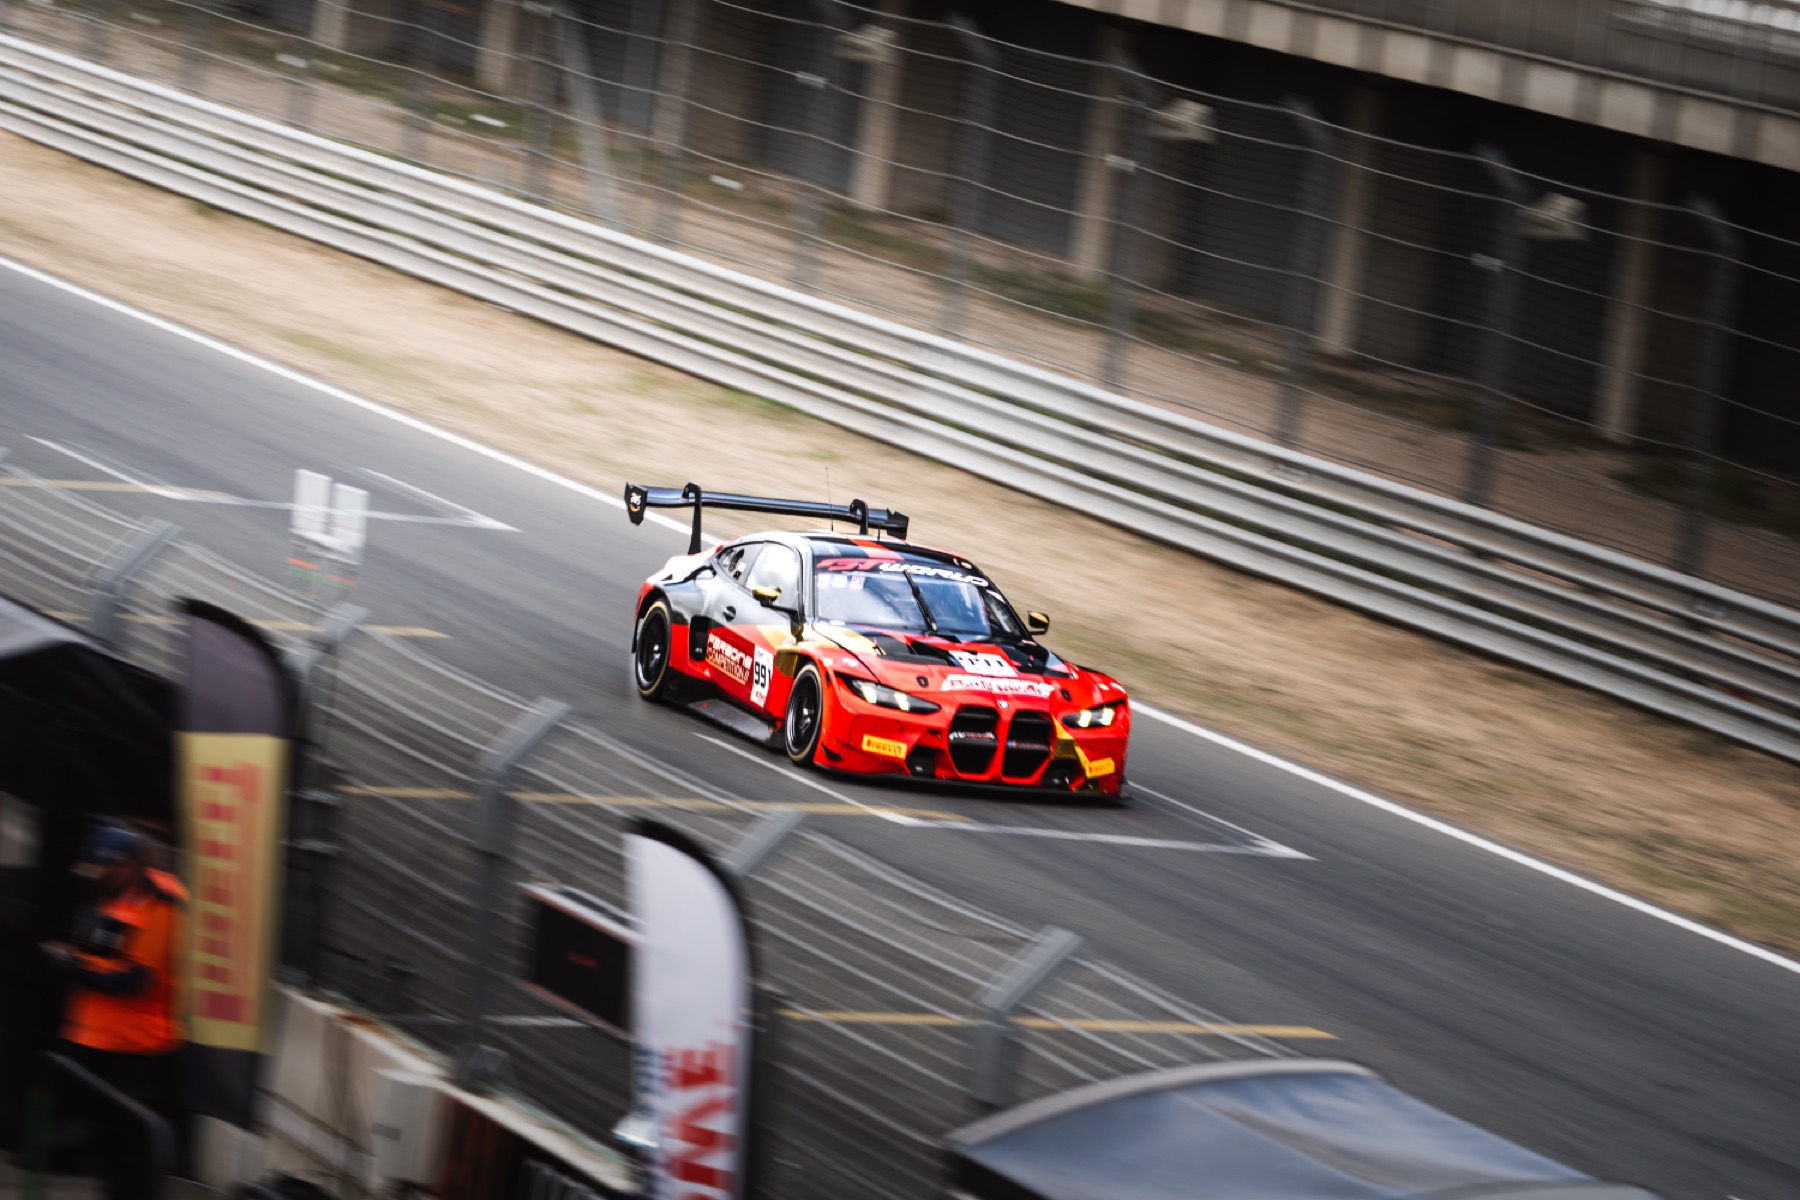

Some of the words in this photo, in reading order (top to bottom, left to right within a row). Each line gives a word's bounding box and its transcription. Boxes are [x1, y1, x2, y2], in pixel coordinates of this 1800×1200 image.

[816, 558, 897, 571] GT
[879, 562, 989, 588] WORLD
[754, 660, 772, 689] 991
